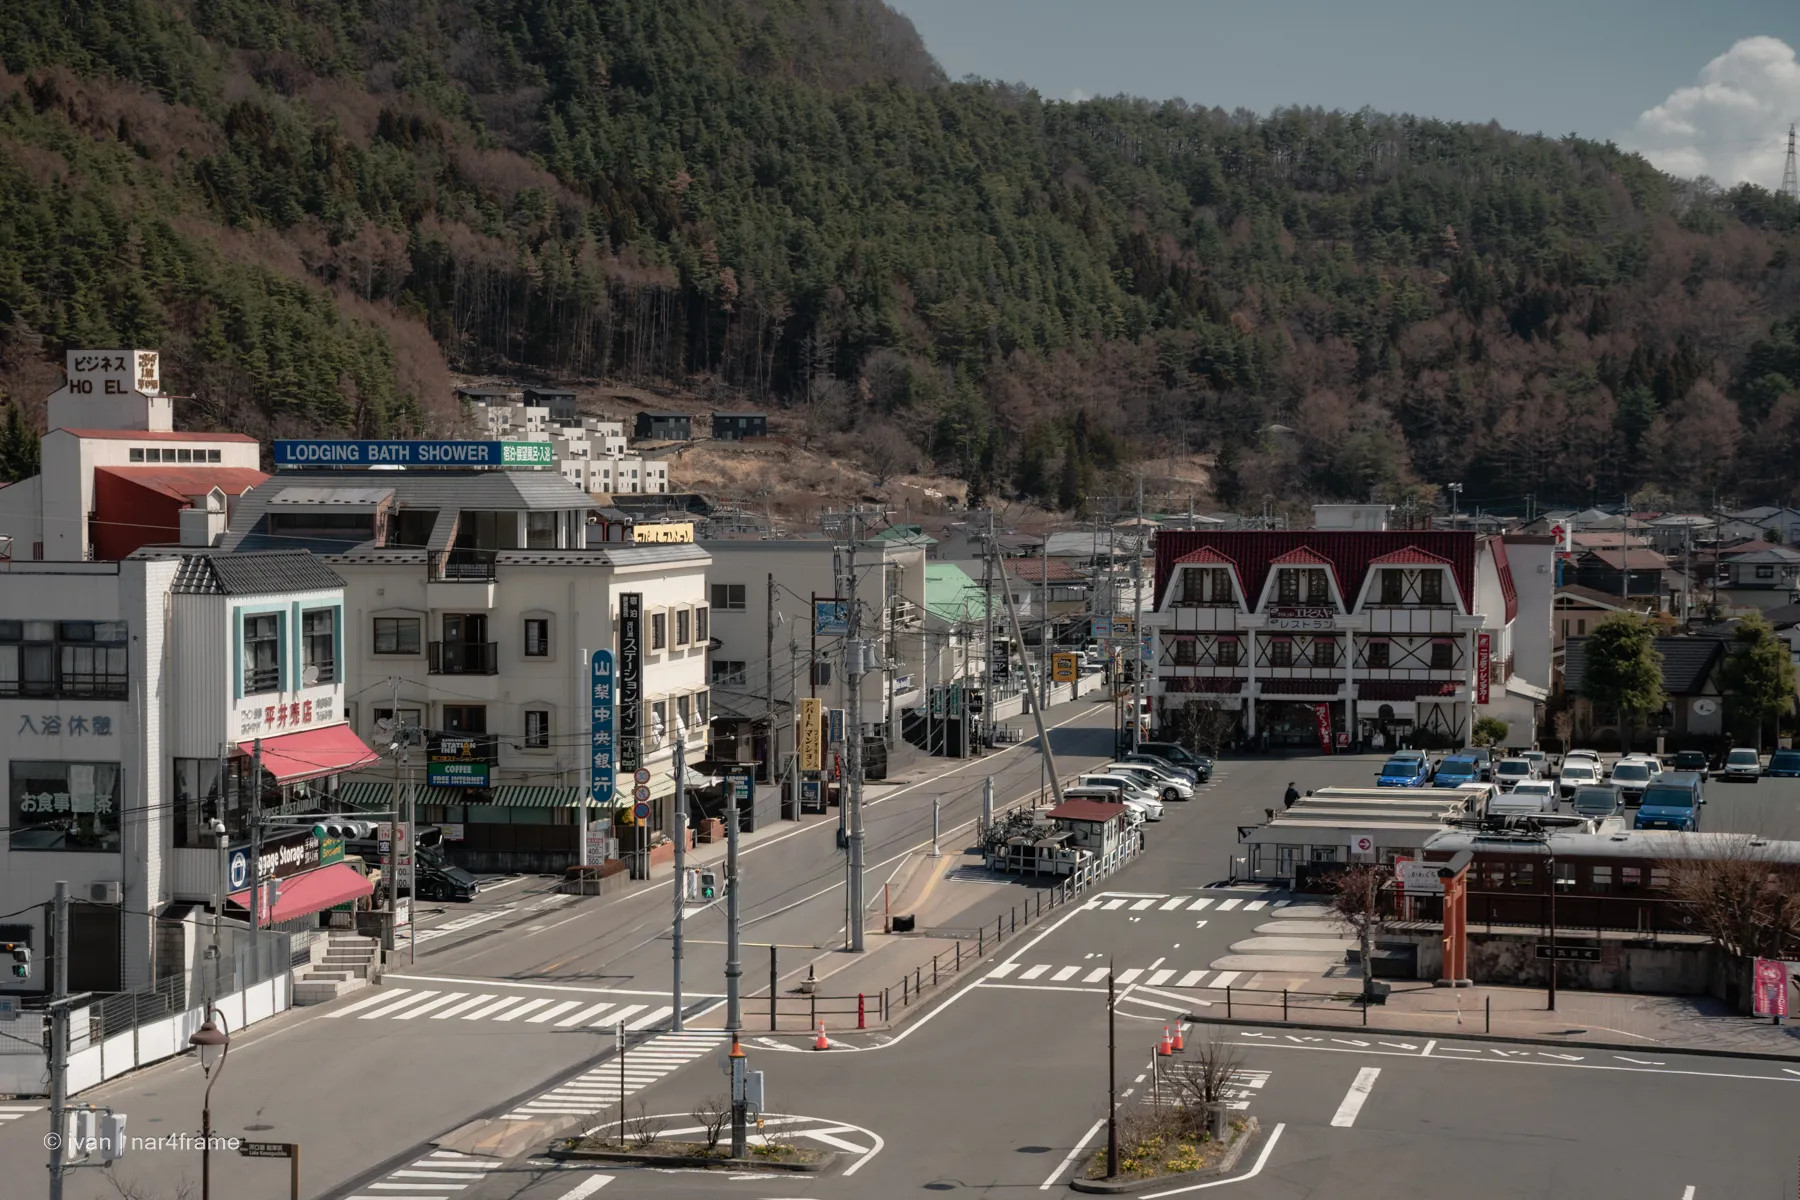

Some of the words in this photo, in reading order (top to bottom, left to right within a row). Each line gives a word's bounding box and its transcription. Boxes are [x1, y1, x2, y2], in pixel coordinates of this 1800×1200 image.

[75, 356, 126, 372] ビジネス
[286, 445, 359, 461] LODGING
[368, 445, 410, 461] BATH
[418, 445, 489, 461] SHOWER
[1280, 620, 1333, 629] レストラン
[593, 661, 612, 793] 山梨中央銀行
[445, 765, 472, 774] COFFEE
[432, 775, 450, 784] FREE
[451, 776, 484, 785] INTERNET
[279, 845, 304, 865] Storage
